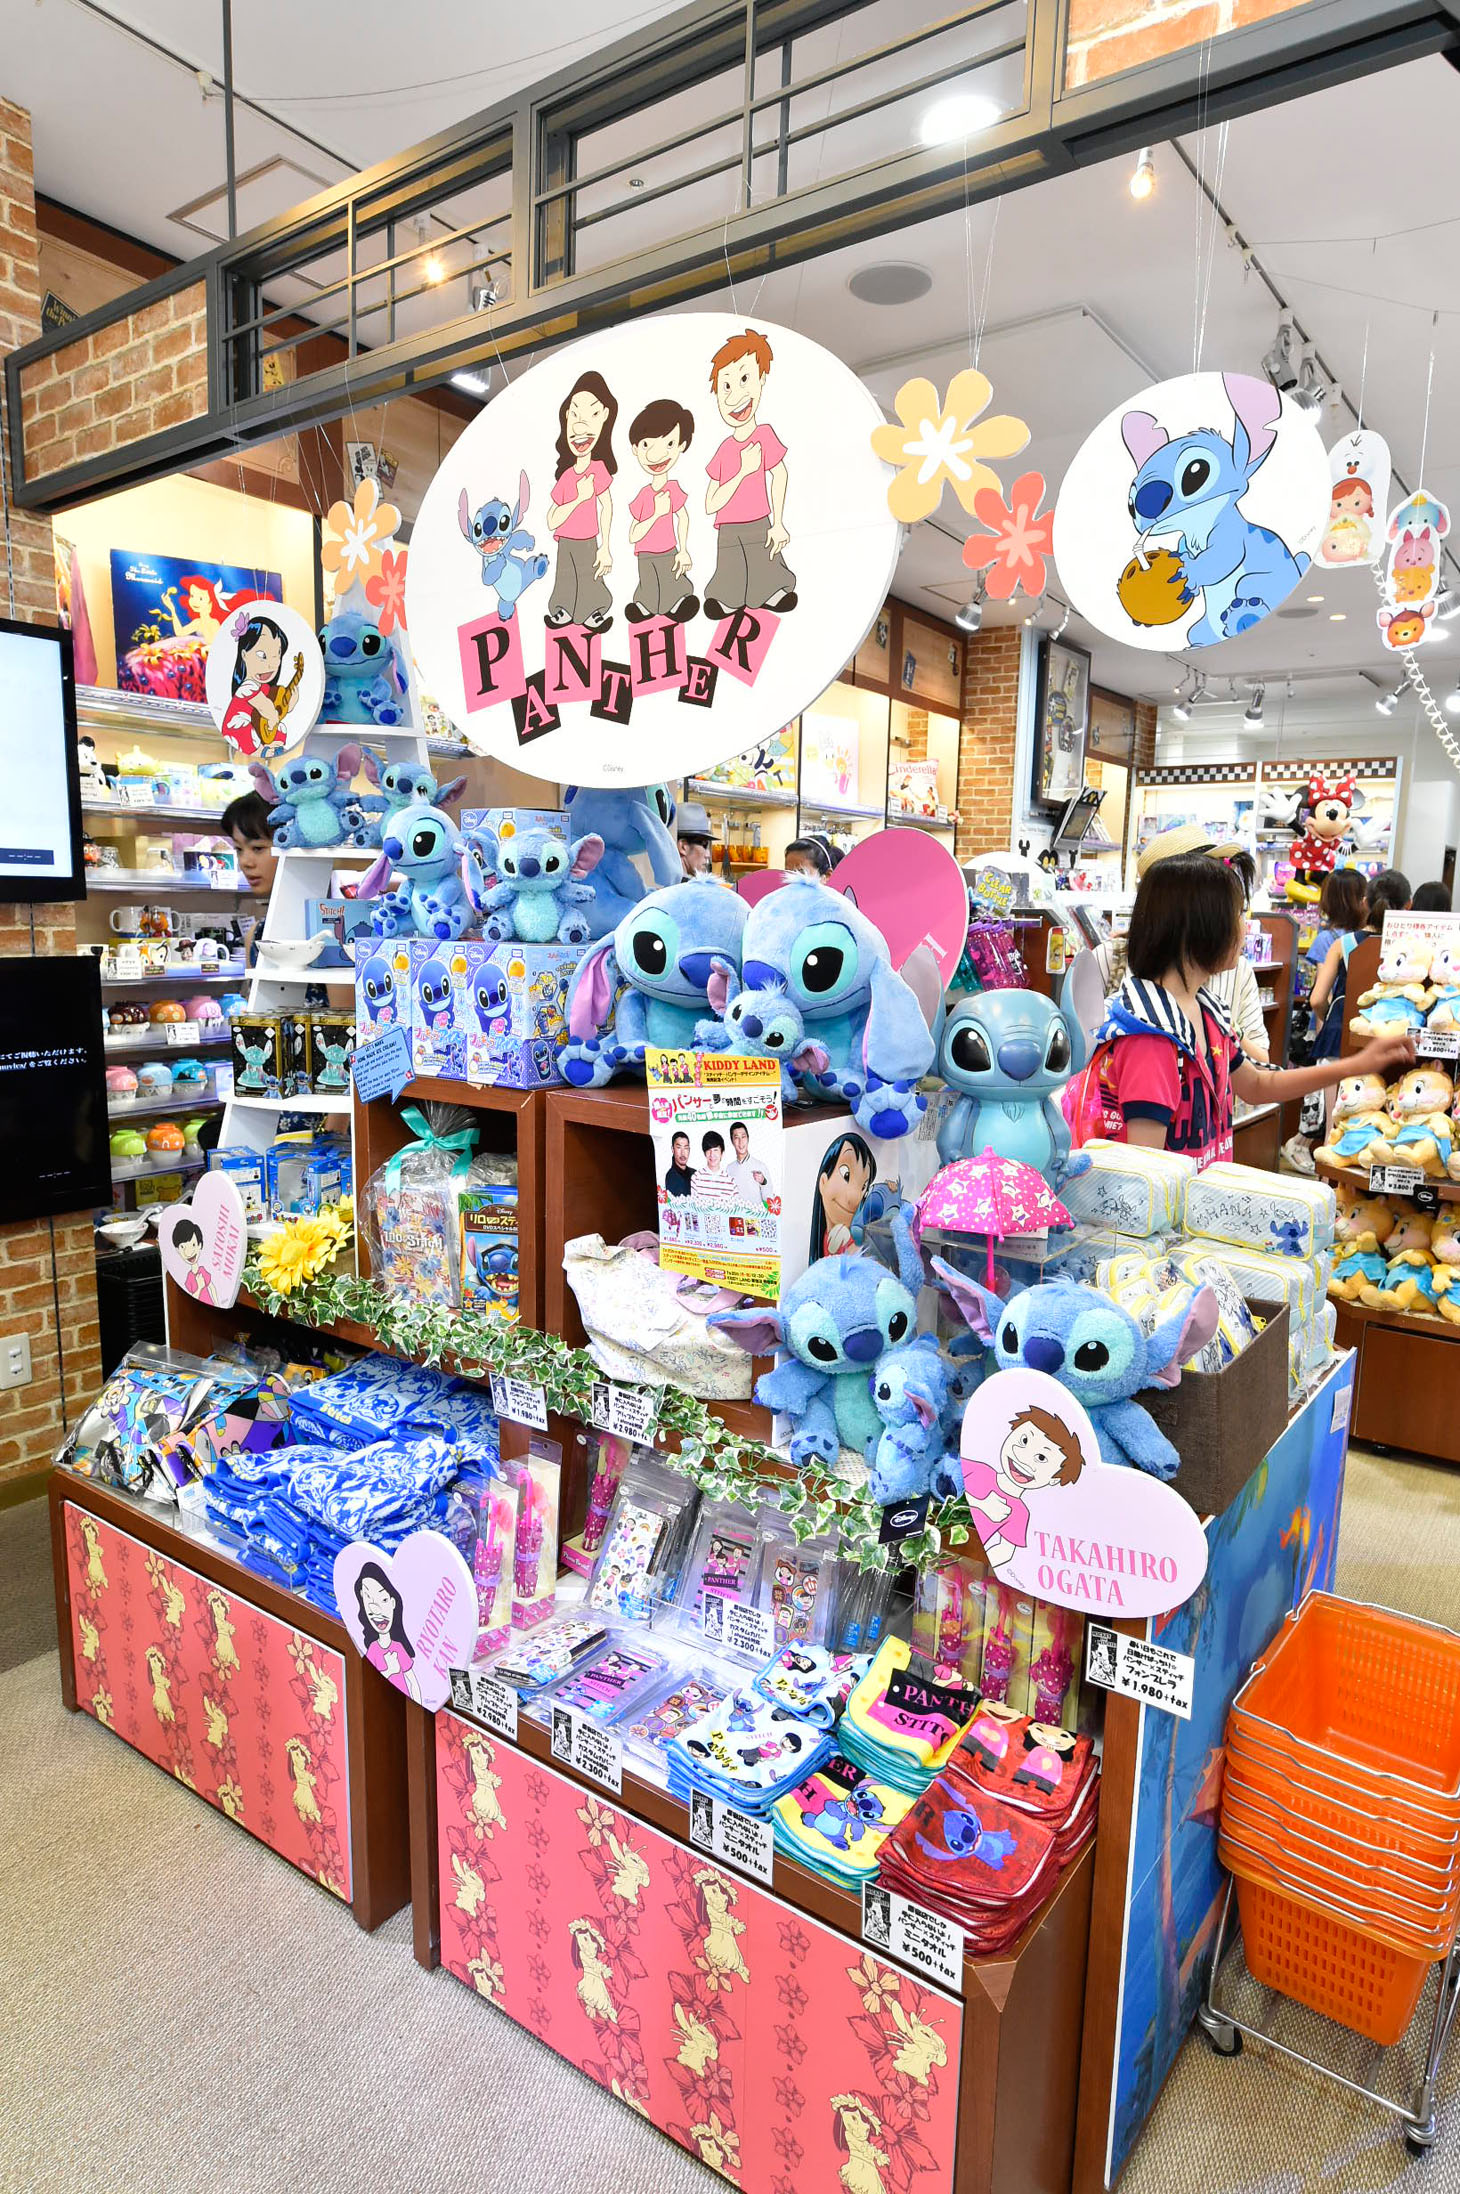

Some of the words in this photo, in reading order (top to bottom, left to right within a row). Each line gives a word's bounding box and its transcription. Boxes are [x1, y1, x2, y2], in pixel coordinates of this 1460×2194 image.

[471, 606, 761, 736] PANTHER
[978, 883, 1008, 907] BOTTLE
[985, 872, 1011, 894] CLEAR
[704, 1060, 740, 1071] KIDDY
[743, 1060, 776, 1071] LAND
[212, 1204, 231, 1271] SATOSHI
[223, 1225, 240, 1280] MUKAI
[1034, 1530, 1178, 1584] TAKAHIRO
[707, 1575, 736, 1585] PANTHER
[1037, 1564, 1125, 1607] OGATA
[416, 1576, 457, 1660] RYOTARO
[433, 1635, 459, 1680] KAN
[724, 1830, 760, 1857] ミニタオル
[902, 1940, 956, 1980] ¥500+tax
[904, 1928, 946, 1959] ミニタオル
